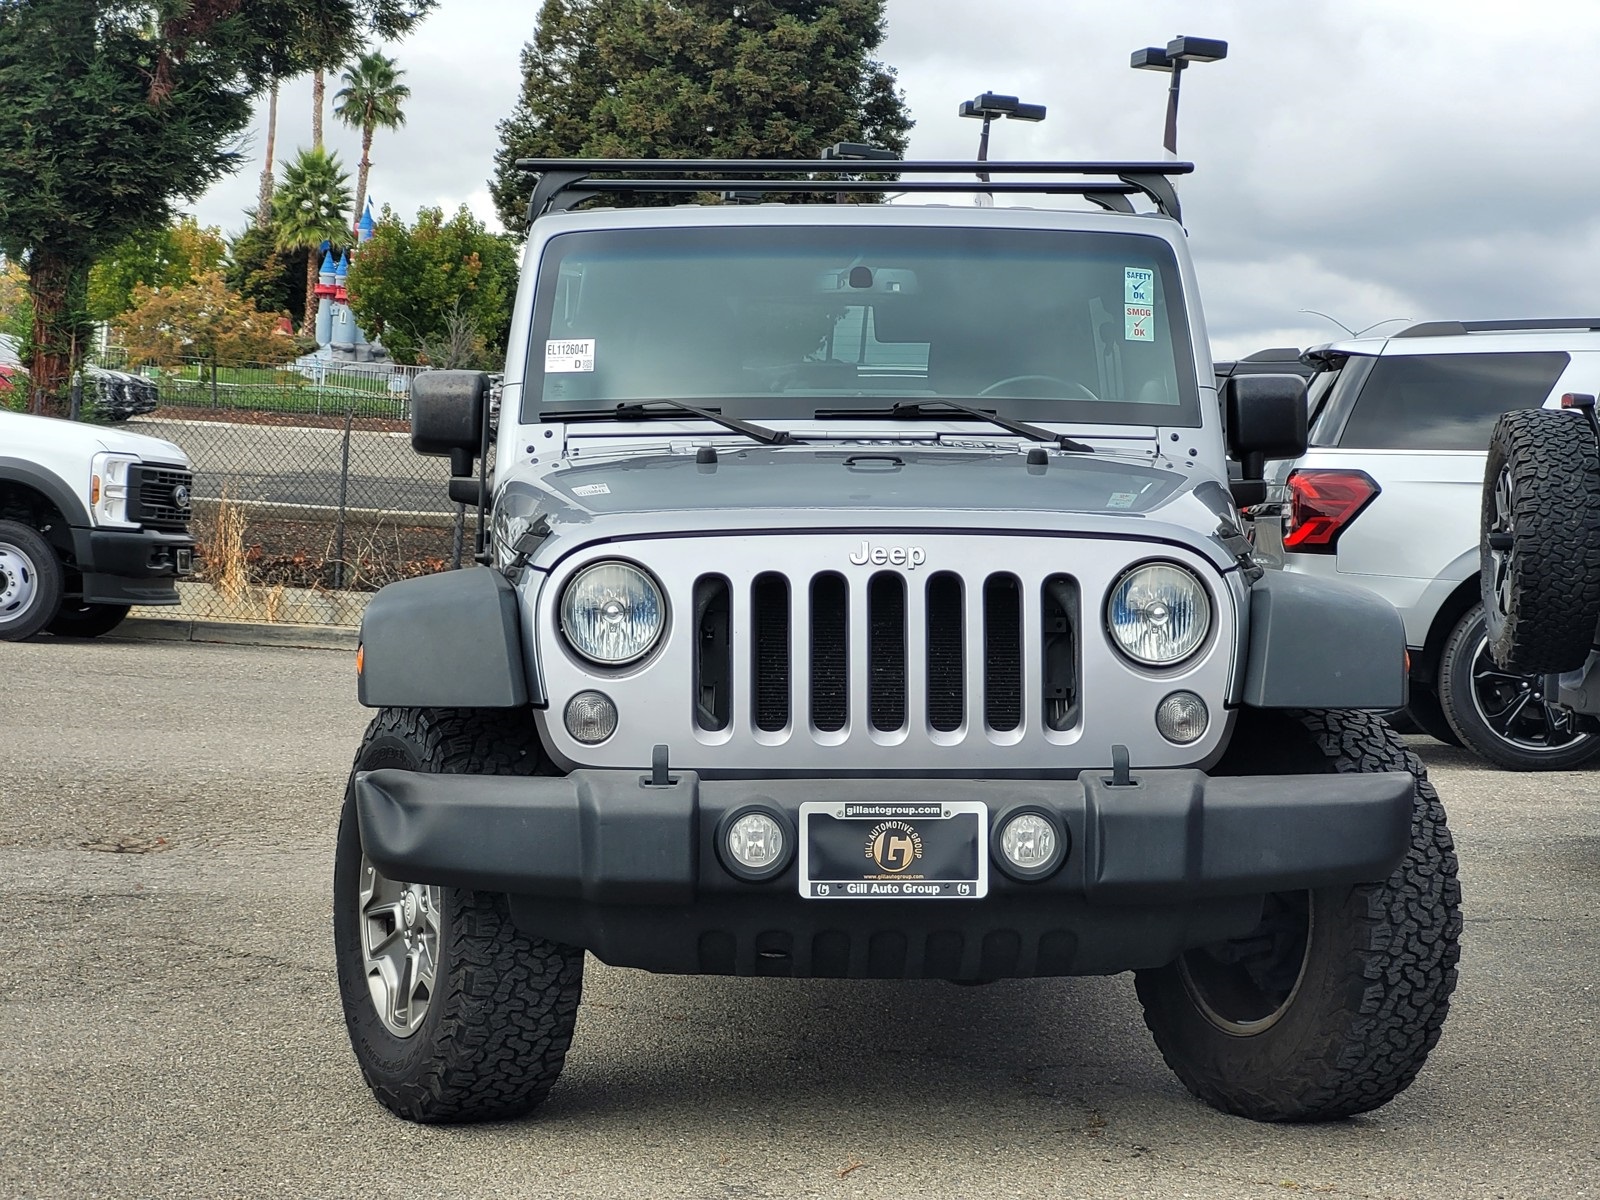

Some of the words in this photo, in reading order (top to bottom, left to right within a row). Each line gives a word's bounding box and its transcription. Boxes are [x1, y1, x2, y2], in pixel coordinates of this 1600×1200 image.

[1126, 271, 1152, 280] SAFETY
[1133, 291, 1145, 300] OK
[1126, 307, 1151, 317] SMOG
[1134, 328, 1145, 337] OK
[547, 343, 589, 355] EL112604T
[574, 359, 582, 369] D
[849, 541, 926, 570] Jeep
[846, 805, 940, 816] gillautogroup.com
[868, 820, 914, 841] AUTOMOTIVE
[864, 841, 874, 858] GILL
[911, 832, 923, 859] GROUP
[846, 883, 868, 894] Gill
[870, 883, 900, 894] Auto
[902, 883, 941, 895] Group
